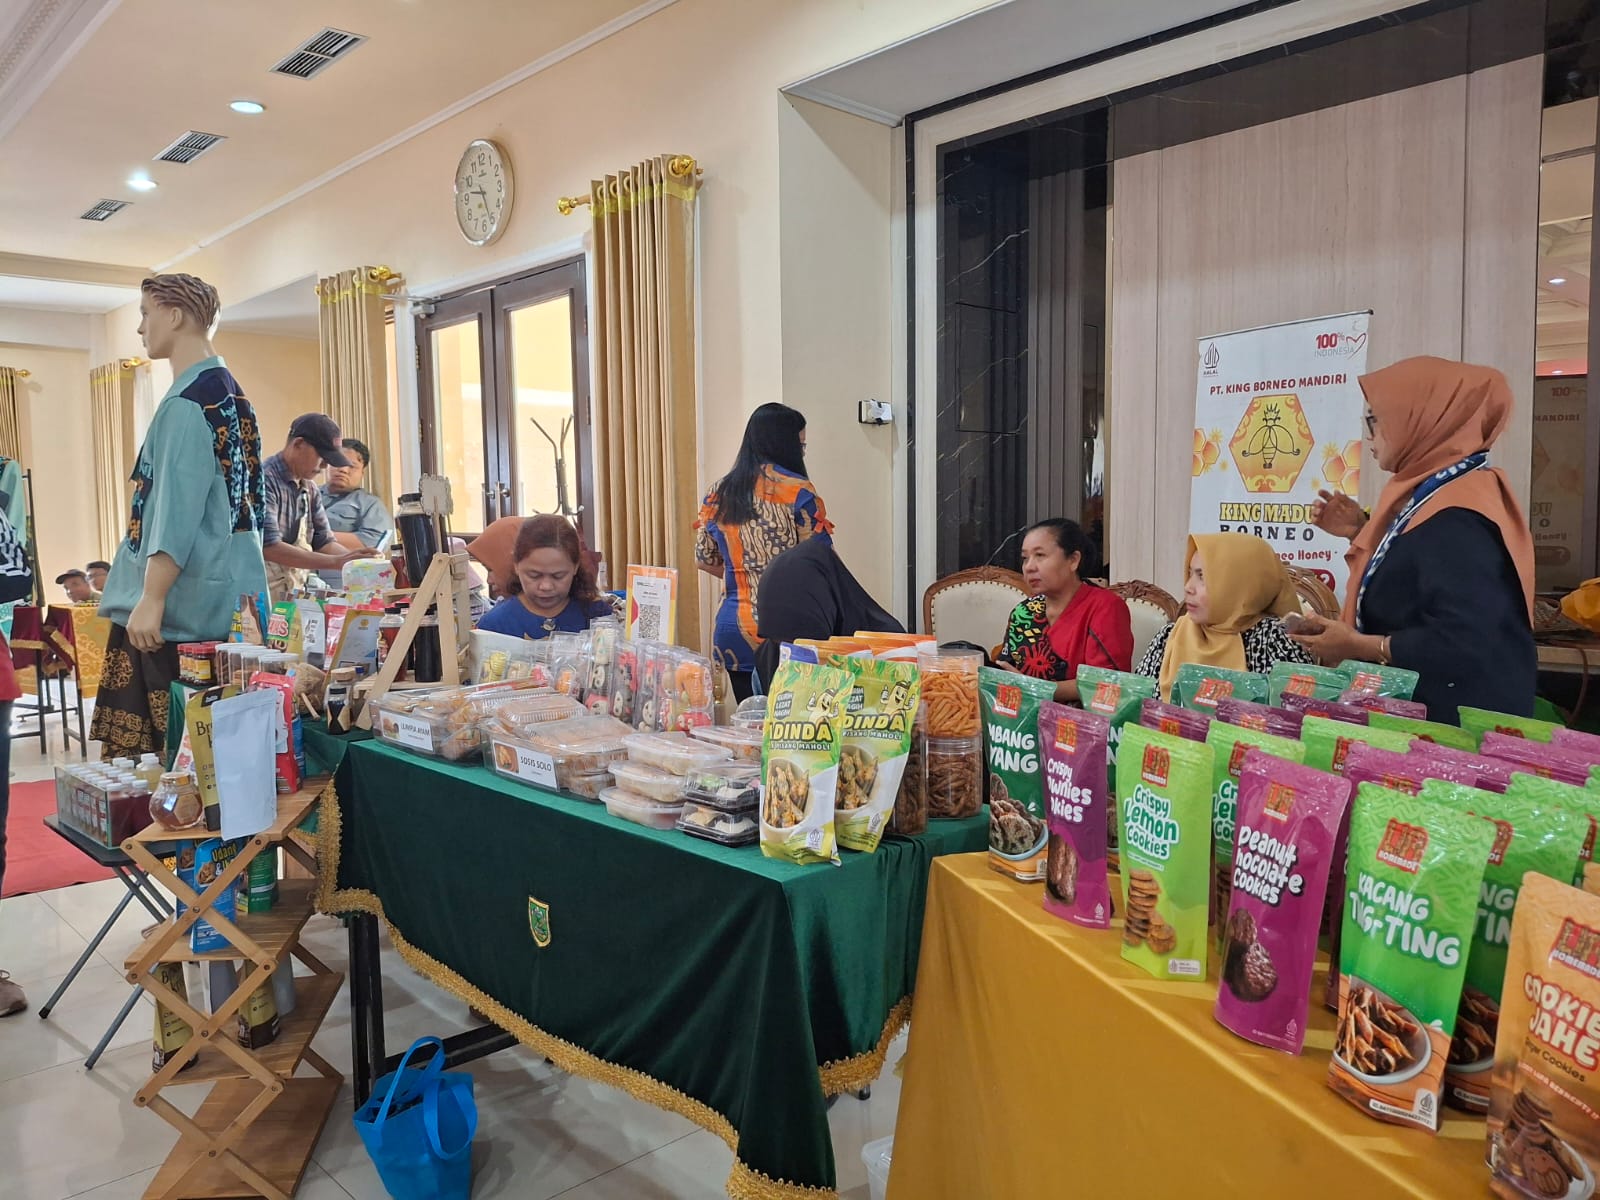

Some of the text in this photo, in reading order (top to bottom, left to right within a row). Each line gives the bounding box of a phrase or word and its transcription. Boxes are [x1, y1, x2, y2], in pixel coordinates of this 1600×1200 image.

[471, 162, 477, 174] 11
[478, 153, 485, 165] 12
[488, 154, 492, 167] 1
[494, 164, 500, 177] 2
[496, 180, 502, 192] 3
[464, 193, 470, 205] 9
[482, 219, 488, 232] 6
[1314, 345, 1355, 358] INDONESIA
[1210, 373, 1347, 395] PT. KING BORNEO MANDIRI
[1220, 502, 1261, 522] KING
[1297, 549, 1332, 562] Honey
[843, 713, 905, 732] DINDA
[870, 731, 902, 740] MAHOLI
[520, 756, 552, 771] SOSIS SOLO
[990, 743, 1038, 773] YANG
[1047, 758, 1073, 782] Crispy
[1135, 786, 1169, 818] Crispy
[1125, 800, 1177, 841] Lemon
[1128, 826, 1168, 857] Cookies
[1238, 826, 1297, 868] Peanut
[1236, 848, 1303, 893] hocolate
[1529, 1007, 1600, 1067] JAHE
[1541, 1050, 1585, 1082] Cookies
